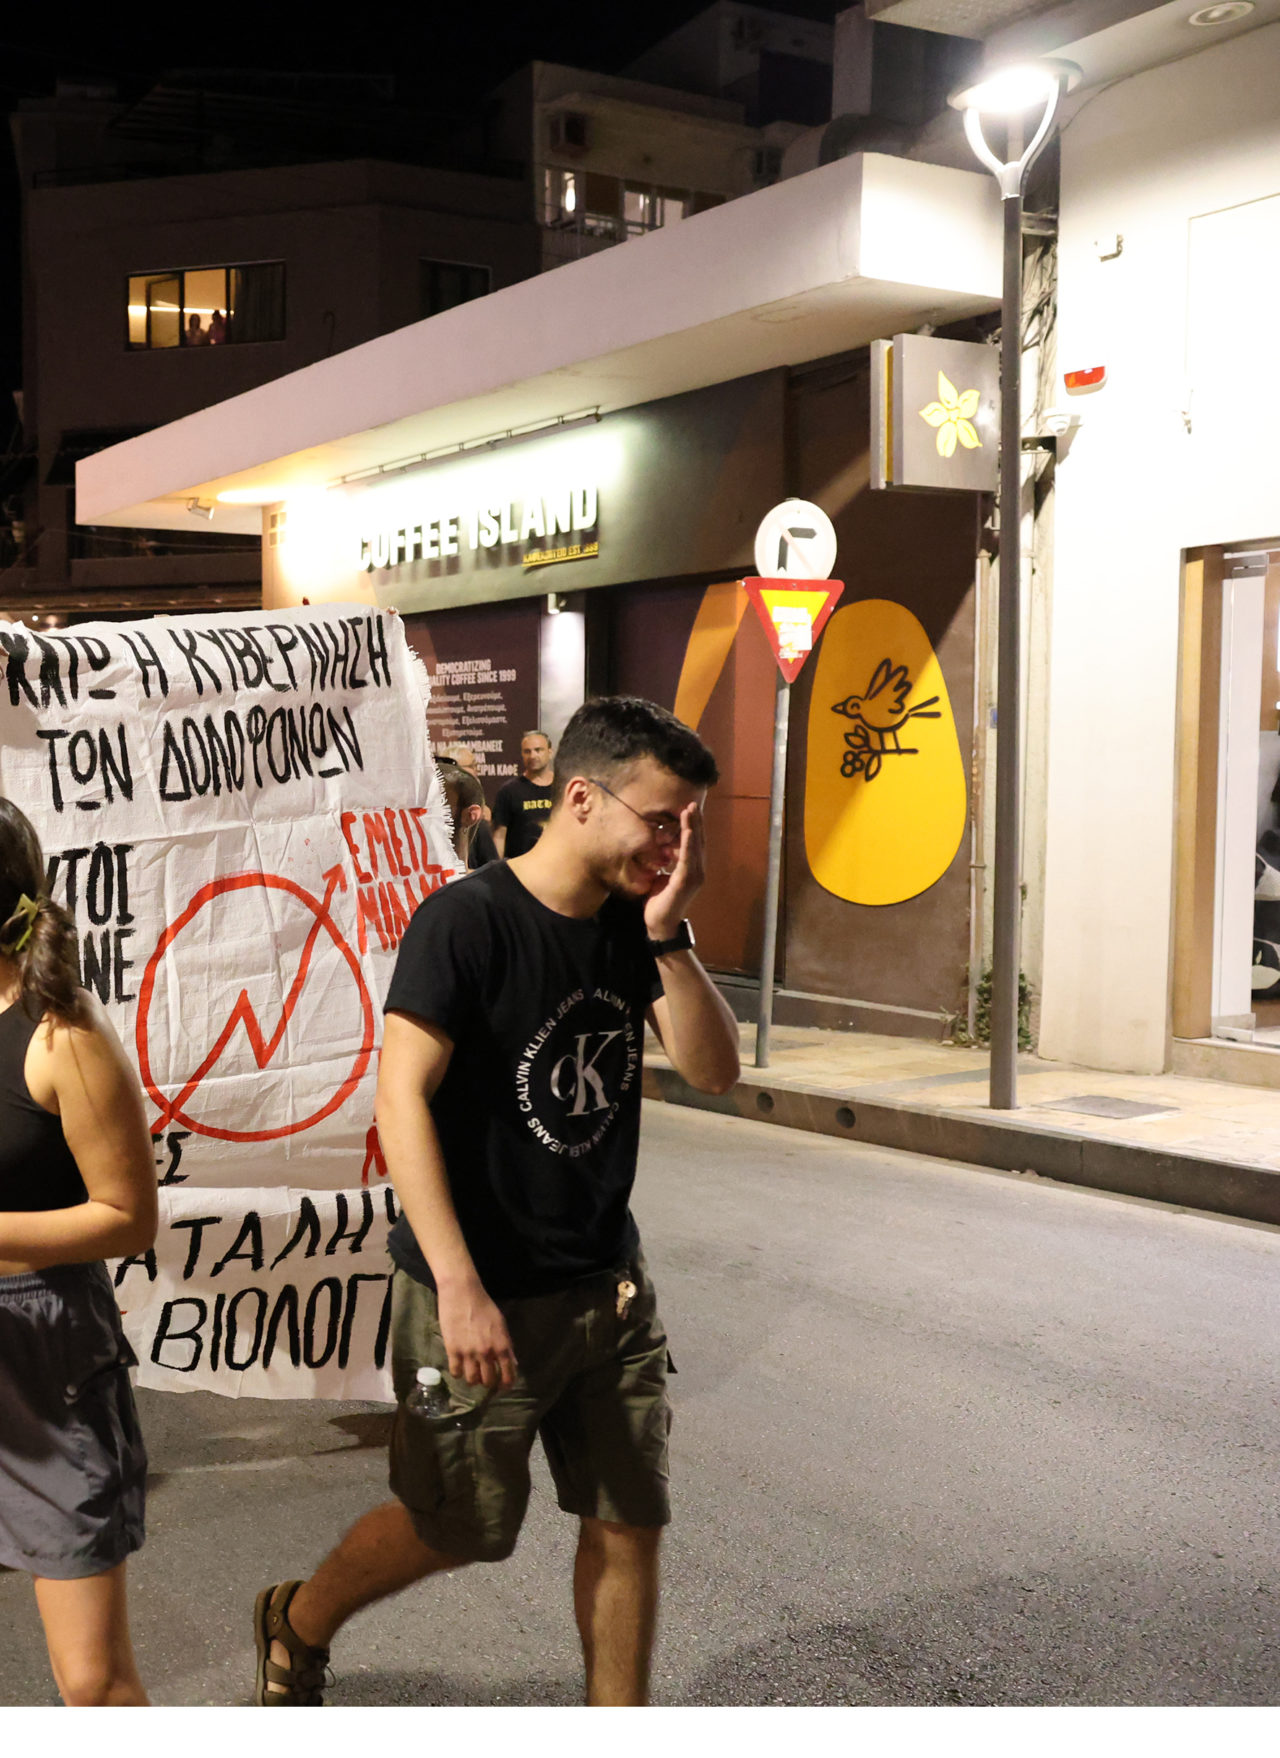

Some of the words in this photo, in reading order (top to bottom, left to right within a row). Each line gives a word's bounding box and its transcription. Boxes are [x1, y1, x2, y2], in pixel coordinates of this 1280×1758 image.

[358, 515, 461, 573] COFFEE
[469, 484, 599, 551] ISLAND
[119, 630, 170, 699] Η
[167, 614, 392, 697] ΚΥΒΕΡΝΗΣΗ
[435, 659, 492, 675] DEMOCRATIZING
[451, 672, 476, 686] COFFEE
[477, 670, 498, 684] SINCE
[499, 669, 517, 682] 1999
[36, 721, 134, 812] ΤΩΝ
[159, 701, 364, 802] ΔΟΛΟΦΟΝΩΝ
[341, 806, 442, 885] ΕΜΕΙΣ
[78, 928, 136, 1006] ΝΕ
[516, 1060, 533, 1112] CALVIN
[527, 1116, 569, 1155] JEANS
